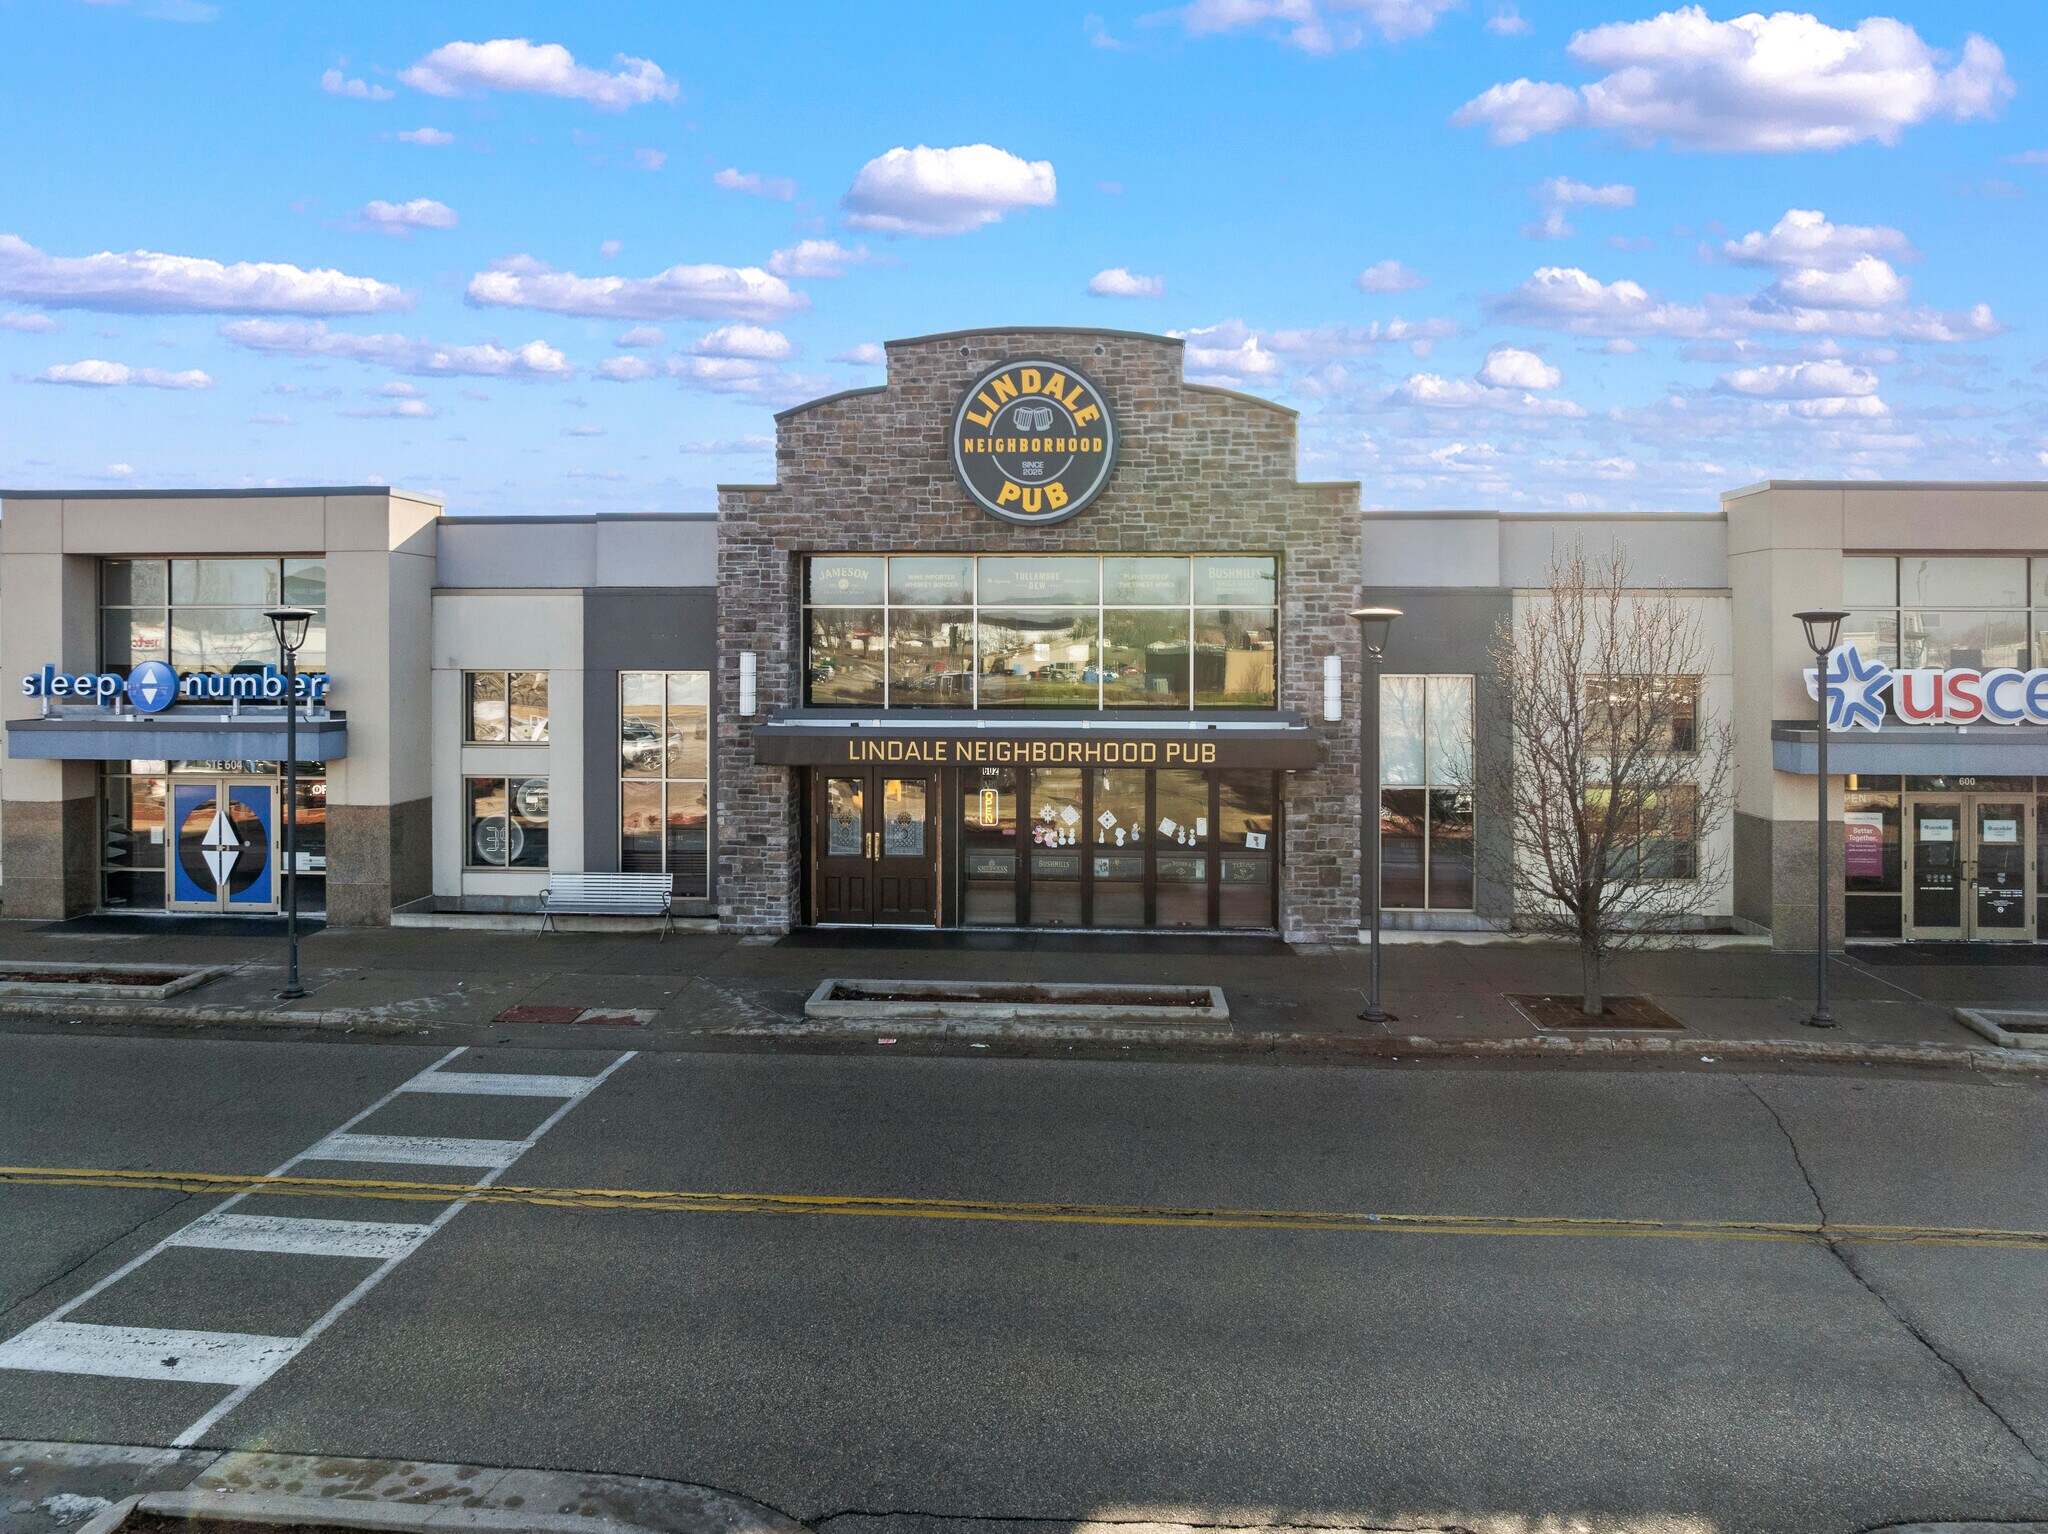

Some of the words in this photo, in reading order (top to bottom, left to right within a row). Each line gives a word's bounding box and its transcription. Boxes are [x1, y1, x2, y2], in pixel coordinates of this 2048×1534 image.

[966, 368, 1101, 428] LINDALE
[964, 437, 1103, 453] NEIGHBORHOOD
[1021, 461, 1044, 469] SINCE
[1022, 468, 1043, 476] 2025
[996, 480, 1069, 513] PUB
[819, 567, 870, 581] JAMESON
[1014, 572, 1060, 581] TULLAMORE
[1208, 567, 1262, 579] BUSHMILLS
[1028, 581, 1046, 590] DEW
[22, 665, 118, 706] sleep
[185, 665, 325, 698] number
[849, 740, 948, 761] LINDALE
[956, 741, 1156, 763] NEIGHBORHOOD
[1166, 743, 1216, 764] PUB
[205, 760, 224, 770] STE
[225, 760, 243, 770] 604
[1958, 777, 1976, 786] 600
[985, 791, 994, 824] OPEN
[1849, 834, 1878, 843] Together.
[1038, 860, 1070, 868] BUSHMILLS
